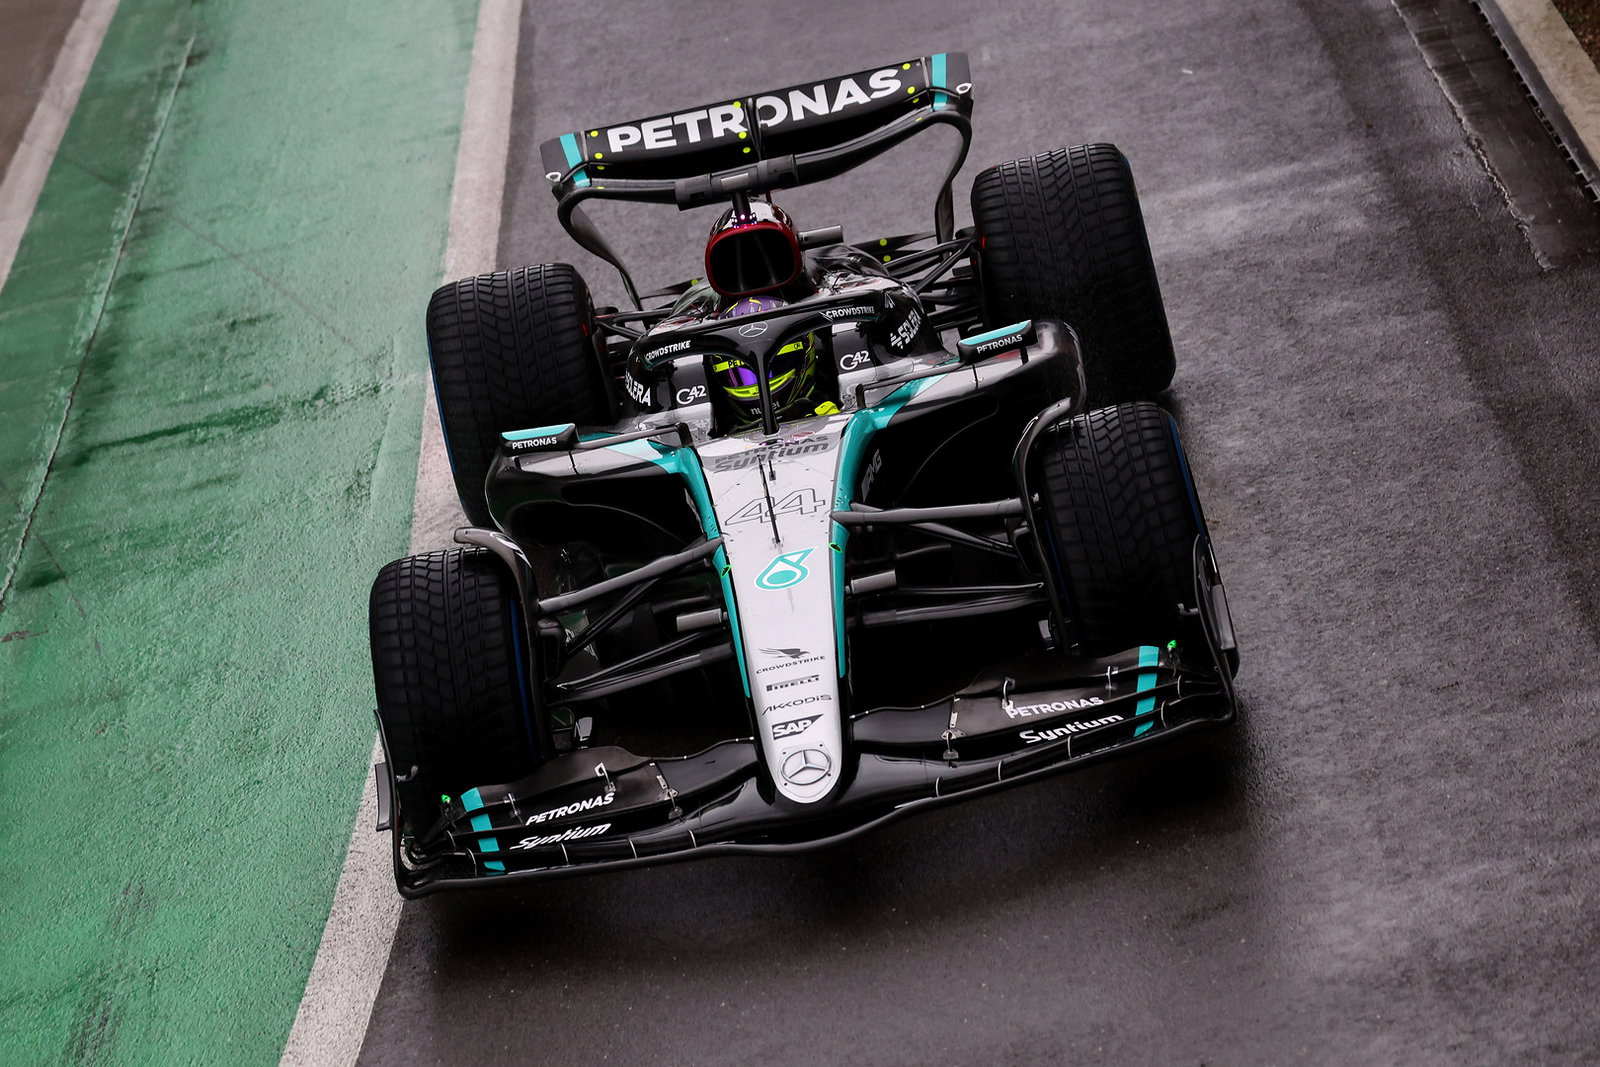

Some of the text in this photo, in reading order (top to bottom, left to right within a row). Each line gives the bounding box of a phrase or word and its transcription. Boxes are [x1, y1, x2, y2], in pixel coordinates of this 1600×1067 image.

[607, 68, 902, 153] PETRONAS
[825, 306, 875, 319] CROWDSTRIKE
[897, 306, 922, 345] SOLERA
[645, 340, 691, 361] CROWDSTRIKE
[976, 334, 1023, 354] PETRONAS
[840, 350, 870, 370] G42
[676, 385, 707, 405] G42
[512, 436, 557, 450] PETRONAS
[713, 443, 829, 474] Syntium
[725, 488, 826, 526] 44
[755, 655, 826, 675] CROWDSTRIKE
[766, 674, 820, 692] PIRELLI
[1004, 696, 1105, 719] PETRONAS
[772, 718, 814, 739] SAP
[1019, 714, 1124, 744] Syntium
[525, 792, 615, 826] PETRONAS
[509, 823, 612, 850] Syntium
